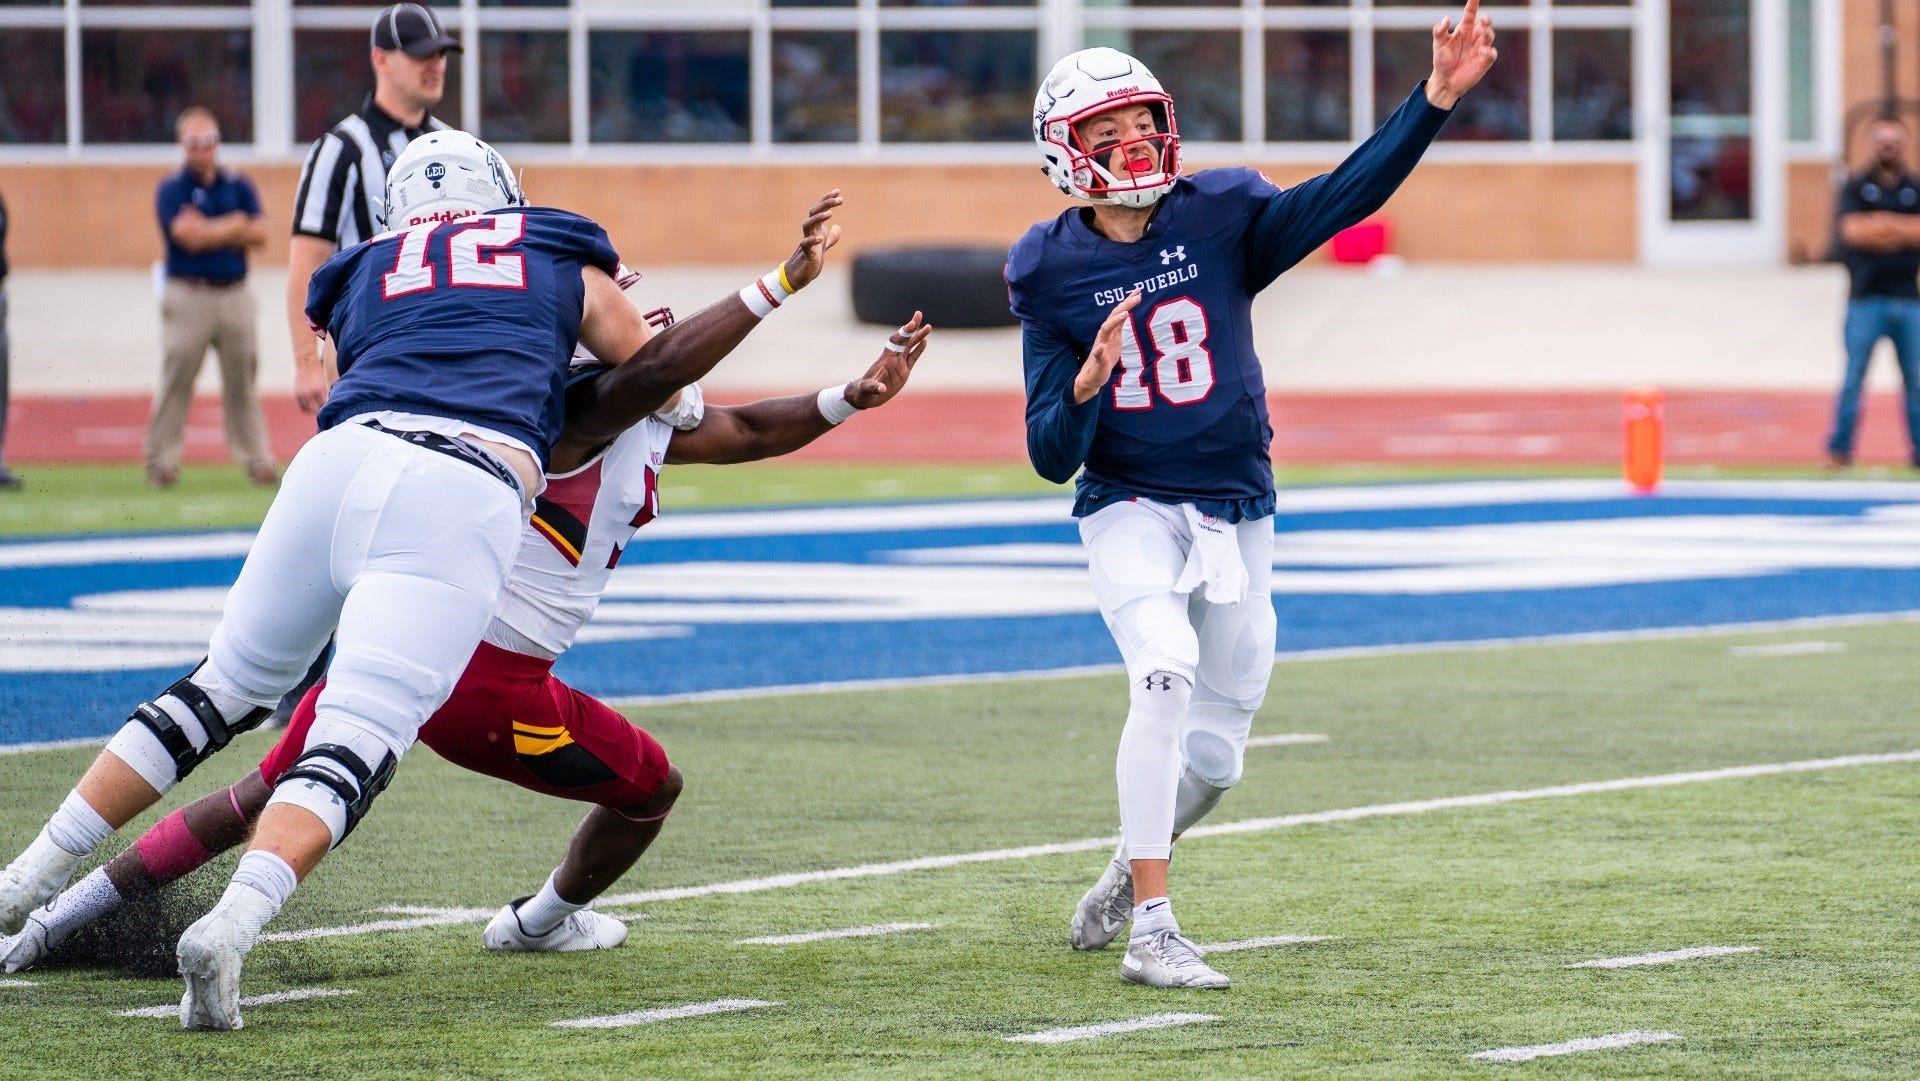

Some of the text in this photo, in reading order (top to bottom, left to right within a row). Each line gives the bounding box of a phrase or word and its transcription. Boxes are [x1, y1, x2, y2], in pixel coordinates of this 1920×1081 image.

[1106, 85, 1140, 98] Riddell
[426, 166, 444, 177] LEO
[1112, 295, 1217, 412] 18
